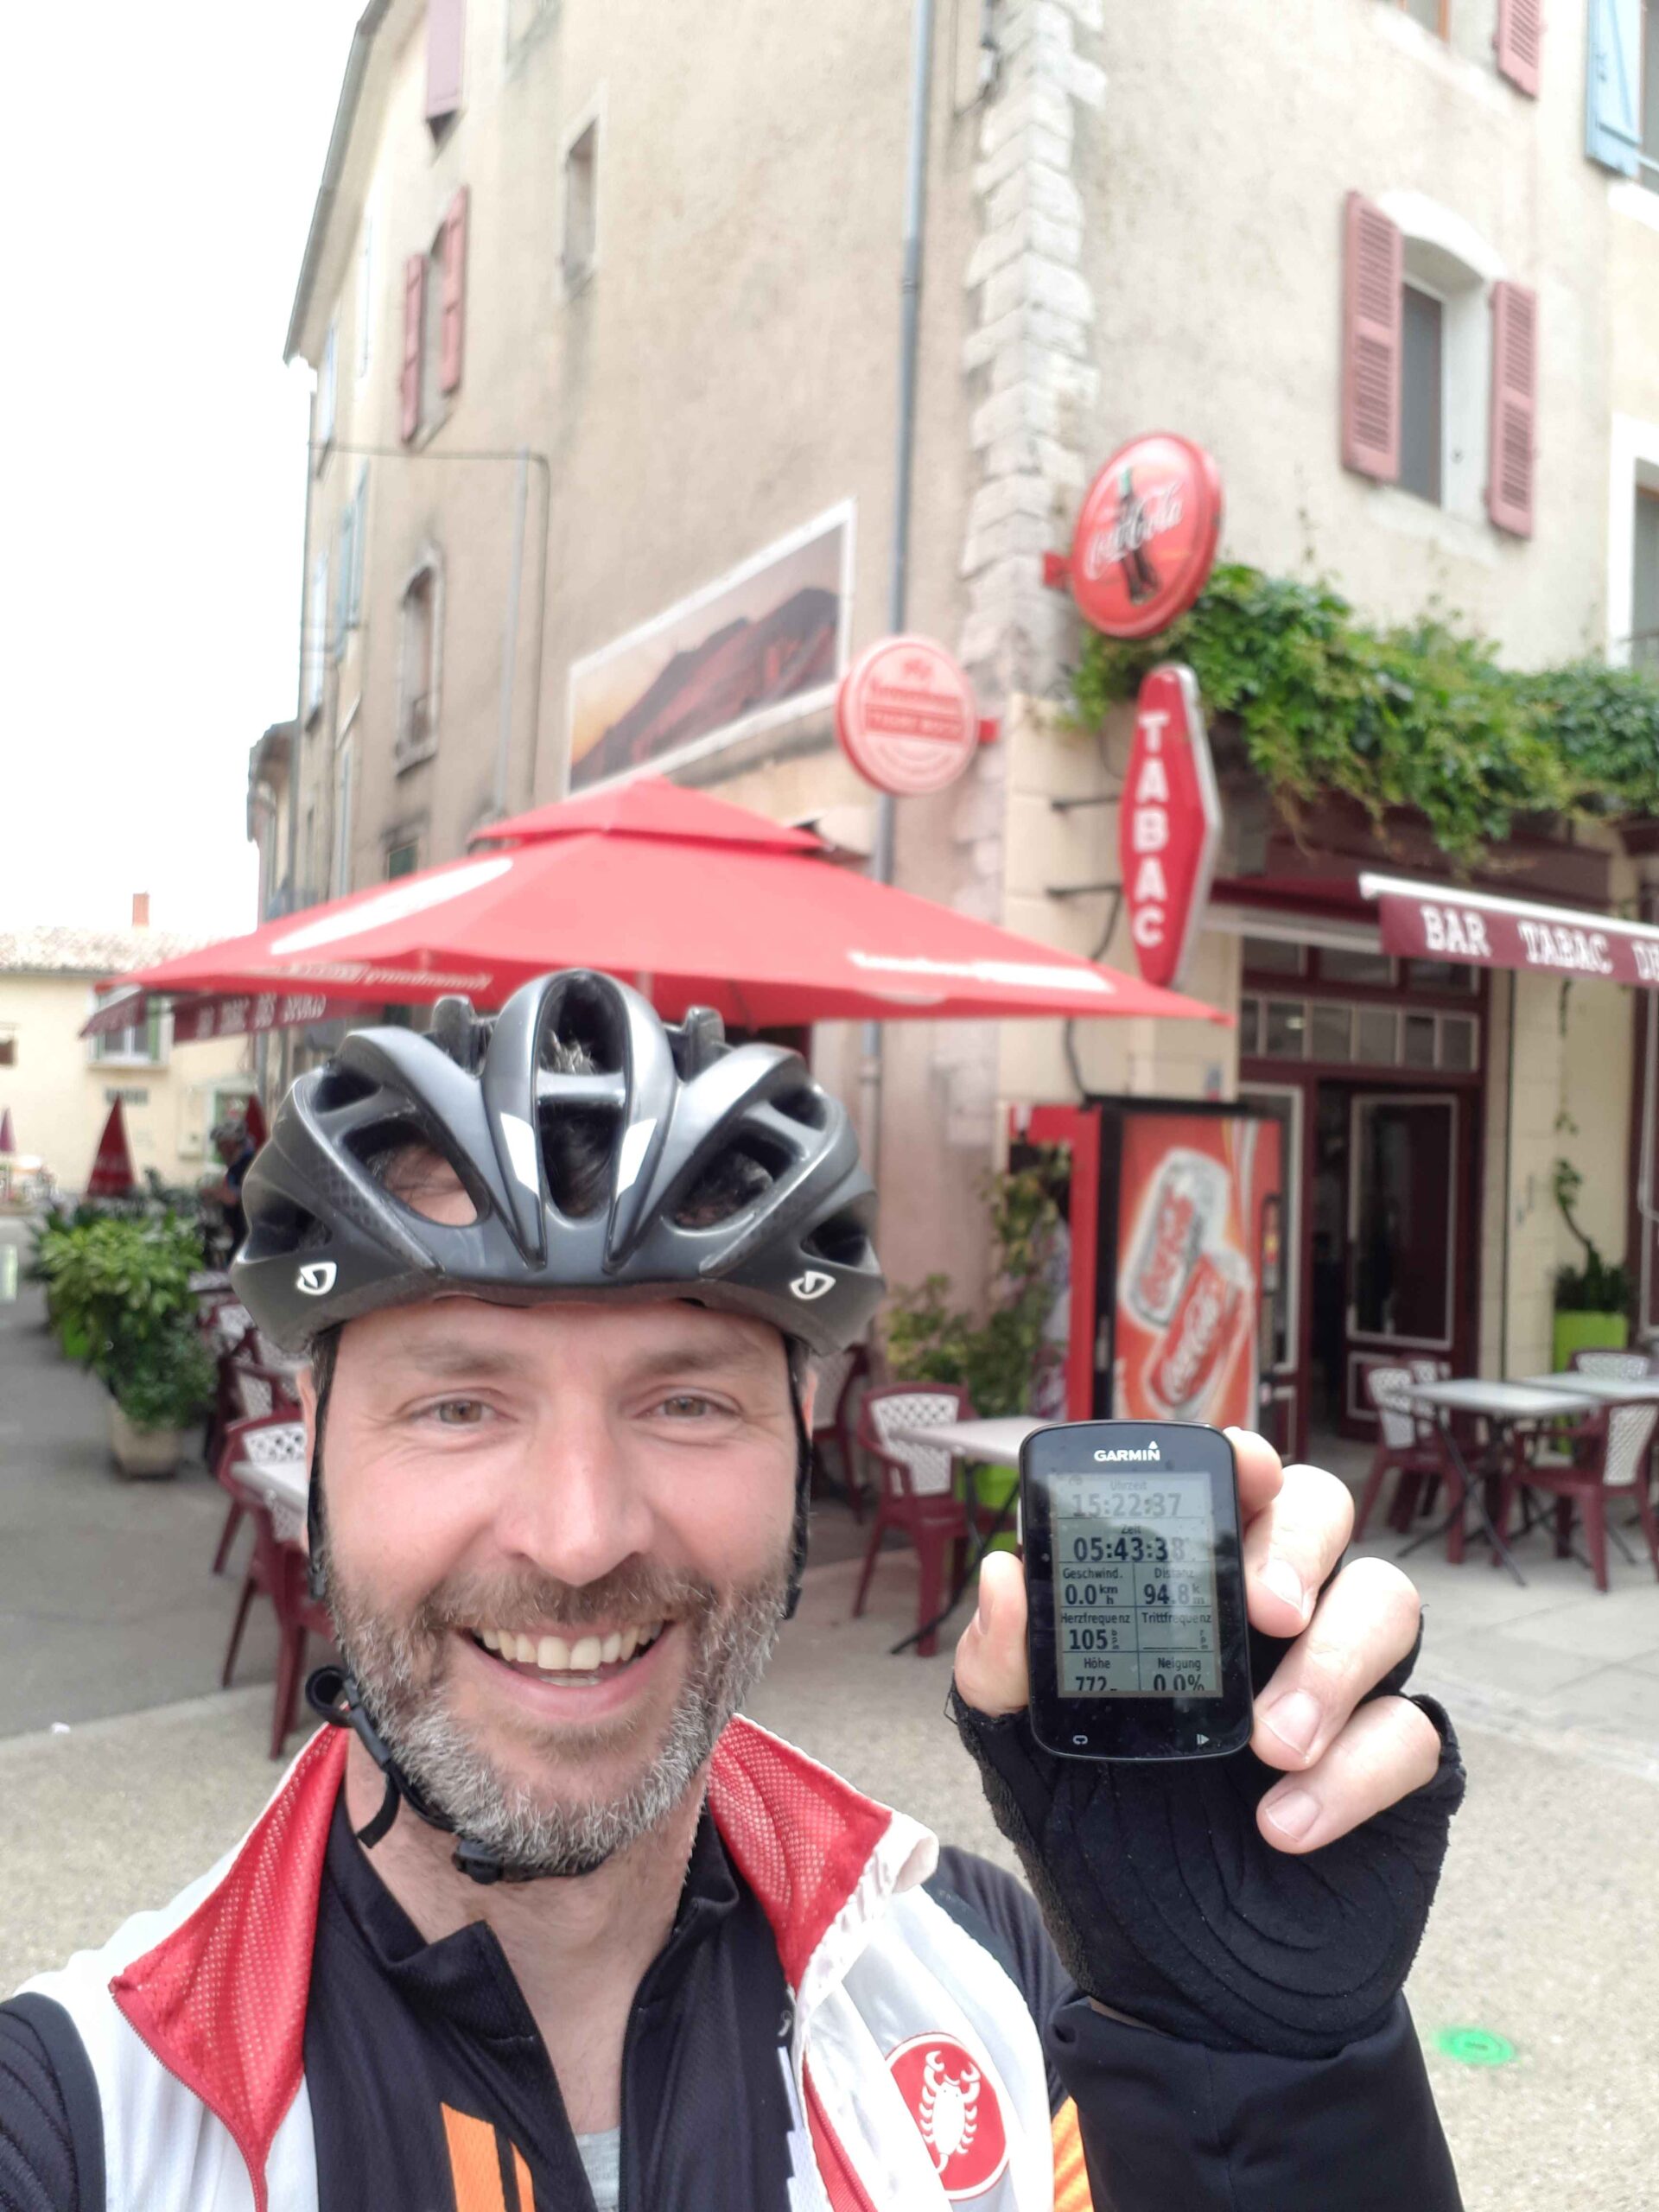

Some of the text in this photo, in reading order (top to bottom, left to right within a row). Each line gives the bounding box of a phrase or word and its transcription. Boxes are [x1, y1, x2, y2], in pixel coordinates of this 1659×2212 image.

[1133, 711, 1170, 947] TABAC
[1421, 906, 1491, 957] BAR
[1517, 921, 1613, 975] TABAC
[1093, 1449, 1160, 1462] GARMIN
[1109, 1479, 1147, 1491] Uhrzeit
[1072, 1492, 1182, 1517] 15:22:37
[1121, 1523, 1141, 1535] Zeit
[1073, 1536, 1185, 1562] 05:43:38
[1063, 1567, 1123, 1580] Geschwind.
[1154, 1567, 1194, 1580] Distanz
[1065, 1583, 1097, 1605] 0.0
[1143, 1583, 1190, 1605] 94.8
[1061, 1611, 1130, 1626] Herzfrequenz
[1141, 1611, 1211, 1626] Trittfrequenz
[1069, 1628, 1108, 1650] 105
[1084, 1657, 1110, 1669] Höhe
[1157, 1657, 1201, 1671] Neigung
[1075, 1675, 1107, 1691] 772
[1153, 1674, 1205, 1691] 00%
